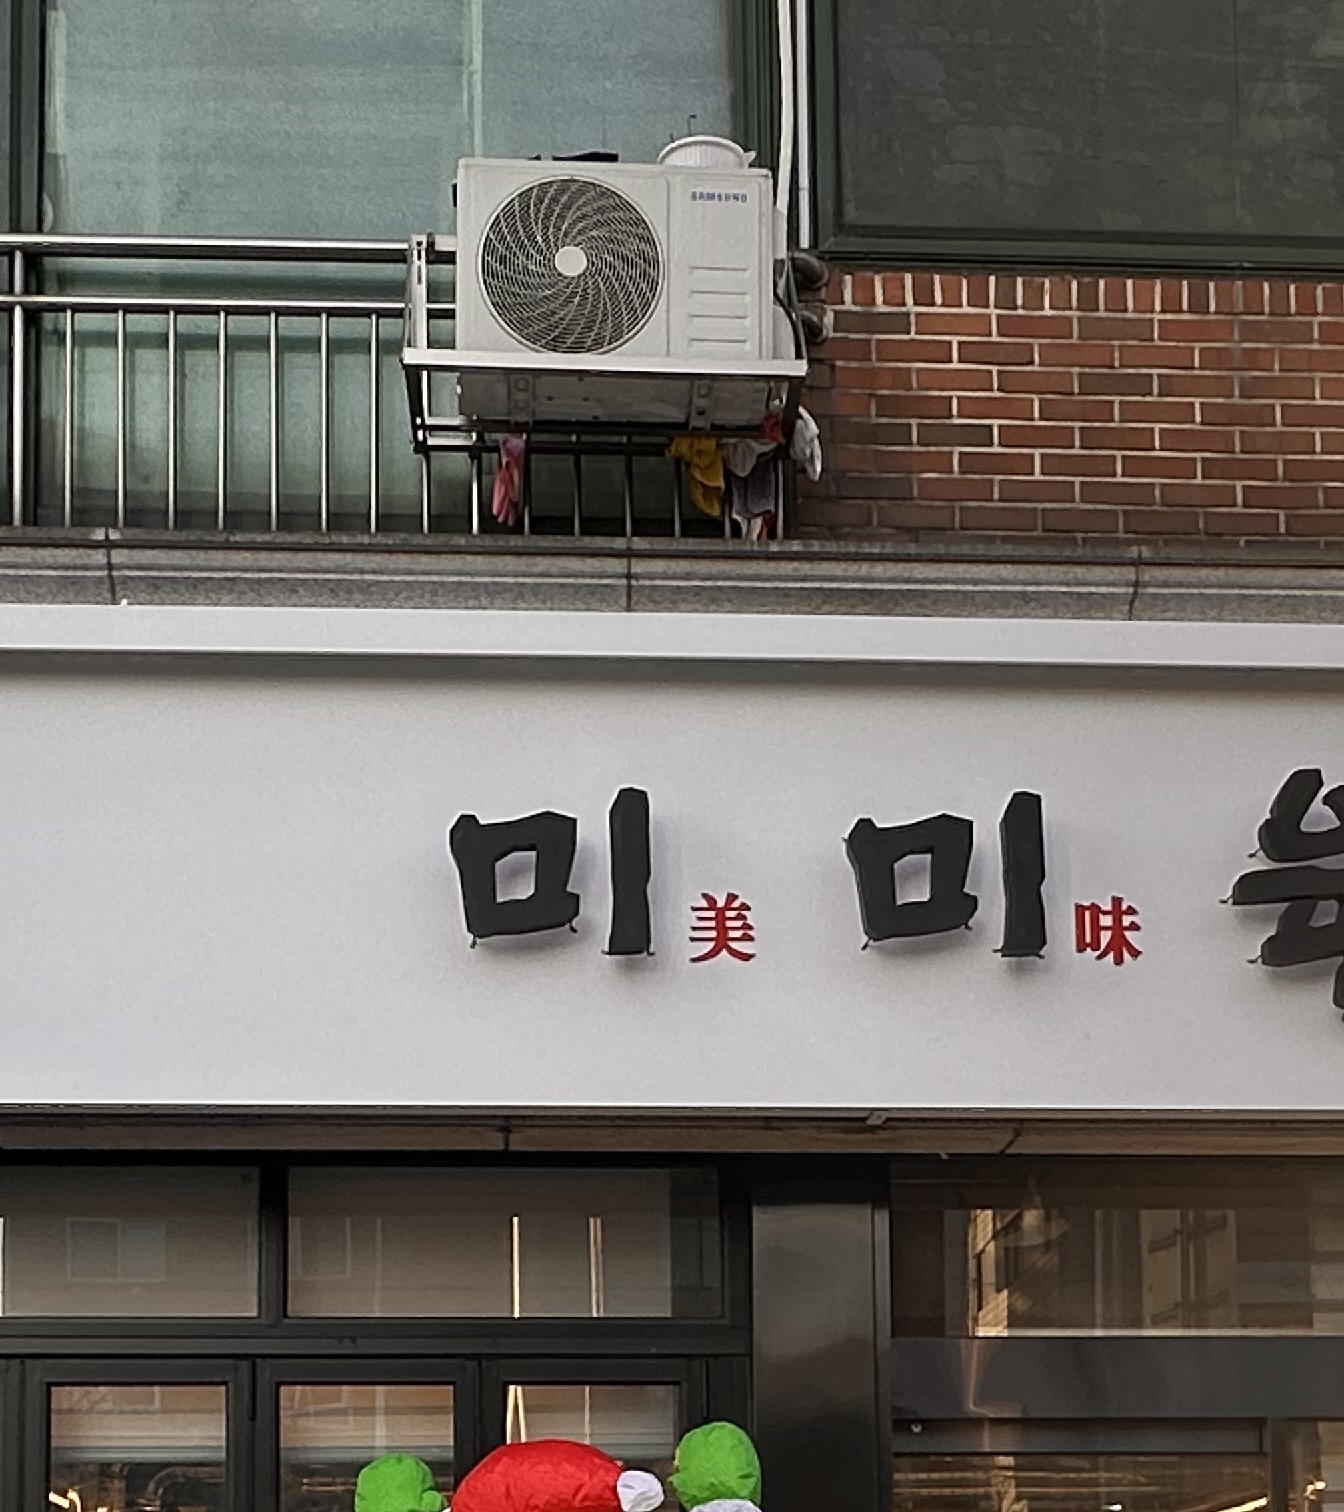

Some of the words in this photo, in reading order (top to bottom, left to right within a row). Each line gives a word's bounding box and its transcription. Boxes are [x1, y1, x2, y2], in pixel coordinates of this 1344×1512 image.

[690, 189, 748, 203] SAMSUNG
[449, 786, 653, 957] 미
[689, 892, 755, 964] 美
[845, 790, 1046, 957] 미
[1074, 896, 1143, 966] 味
